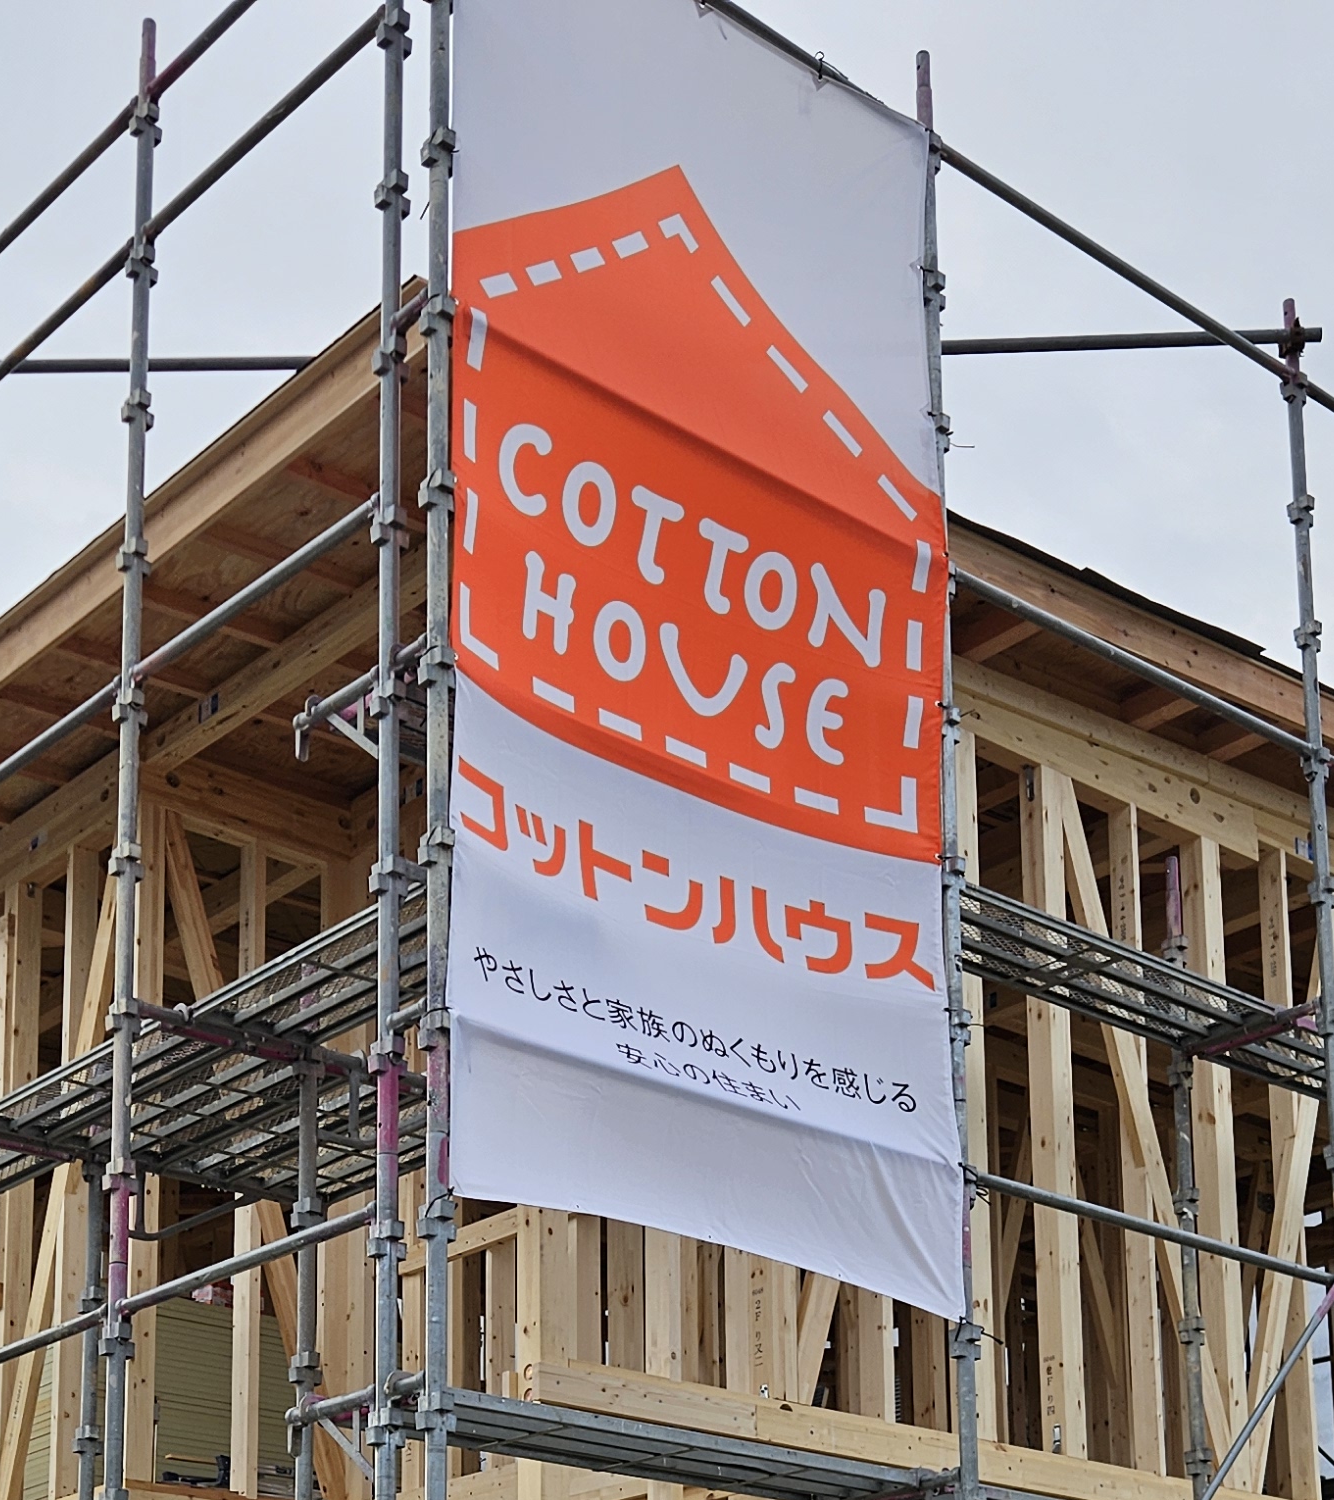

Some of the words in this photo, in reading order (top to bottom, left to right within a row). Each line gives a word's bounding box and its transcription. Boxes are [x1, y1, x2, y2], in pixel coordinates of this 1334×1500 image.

[498, 423, 886, 668] COTTON
[522, 550, 849, 765] HOUSE
[457, 755, 936, 992] コットンハウス
[472, 945, 918, 1114] やさしさと家族のぬくもりを感じる
[615, 1041, 802, 1112] 安心の住まい
